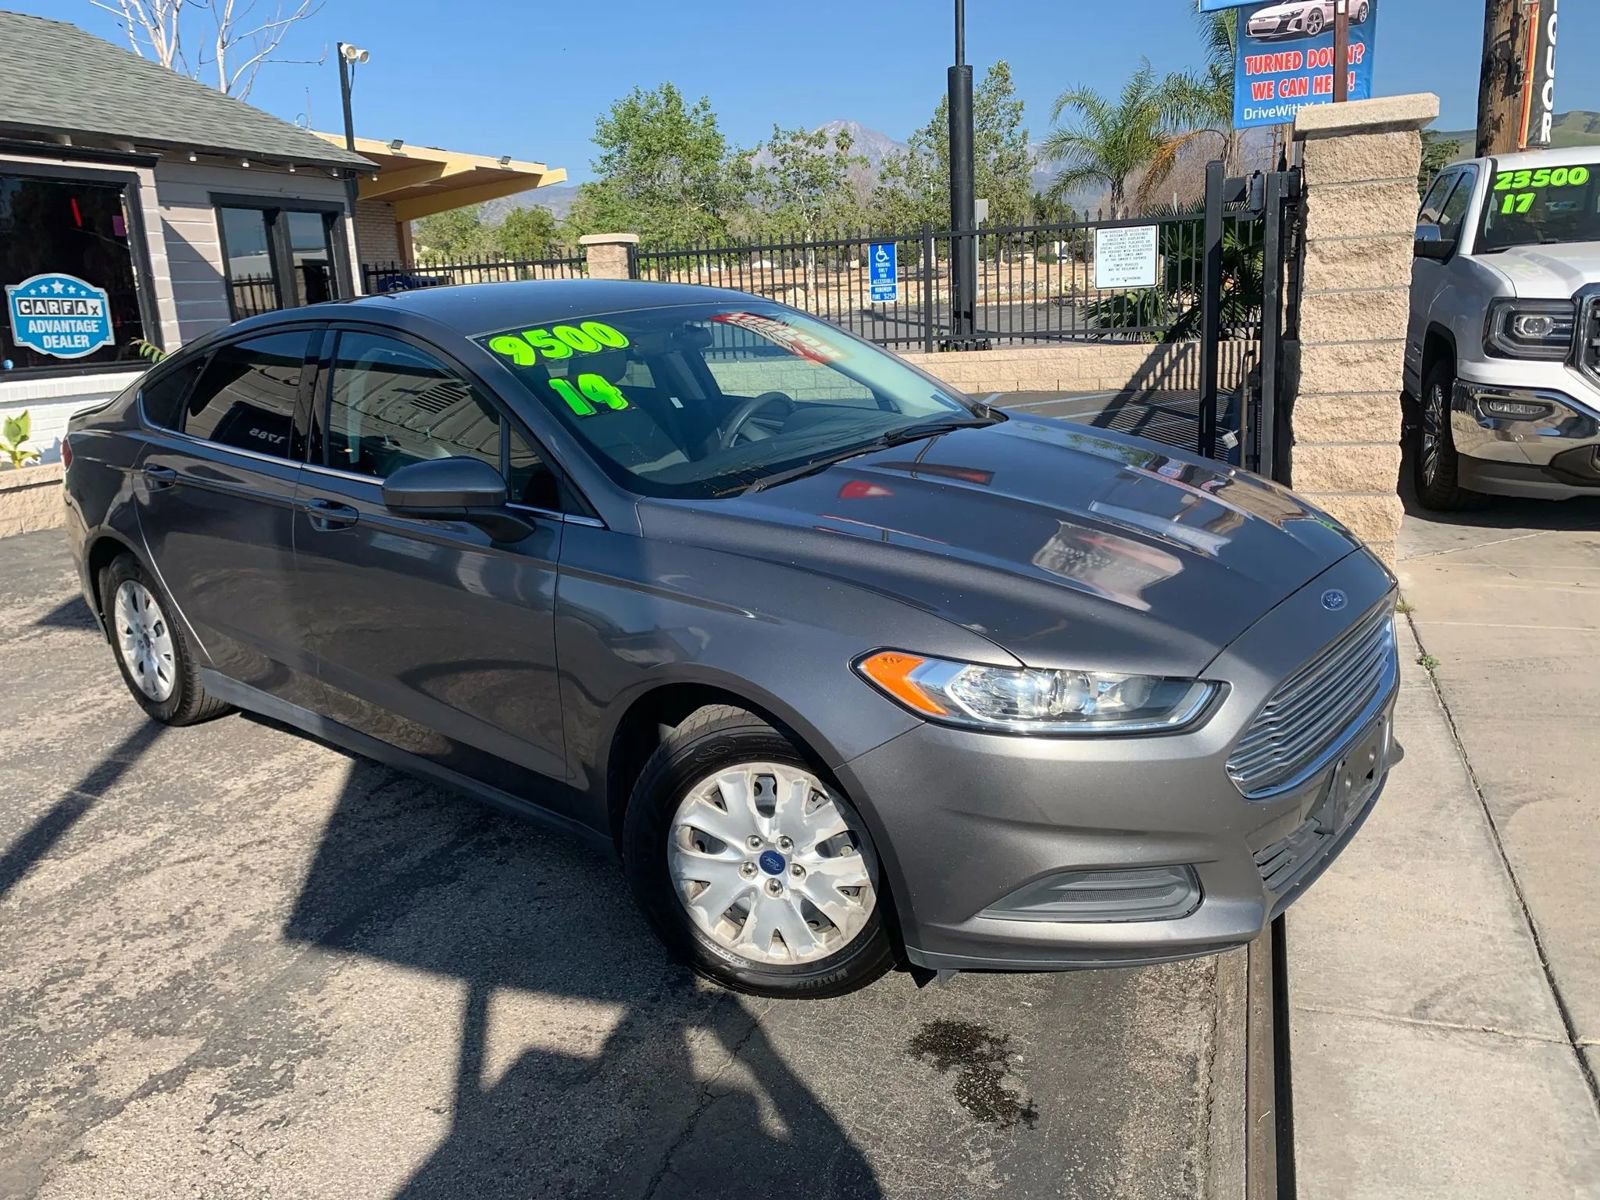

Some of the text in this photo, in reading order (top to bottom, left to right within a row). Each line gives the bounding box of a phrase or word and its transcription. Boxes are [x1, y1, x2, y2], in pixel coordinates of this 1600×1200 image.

[1245, 52, 1303, 76] TURNED
[1252, 71, 1356, 101] WE CAN HE!
[1494, 166, 1589, 190] 23500
[1501, 192, 1536, 215] 17
[19, 300, 100, 316] CARFAX
[43, 334, 90, 349] DEALER
[488, 321, 630, 366] 9500
[548, 373, 629, 416] 14
